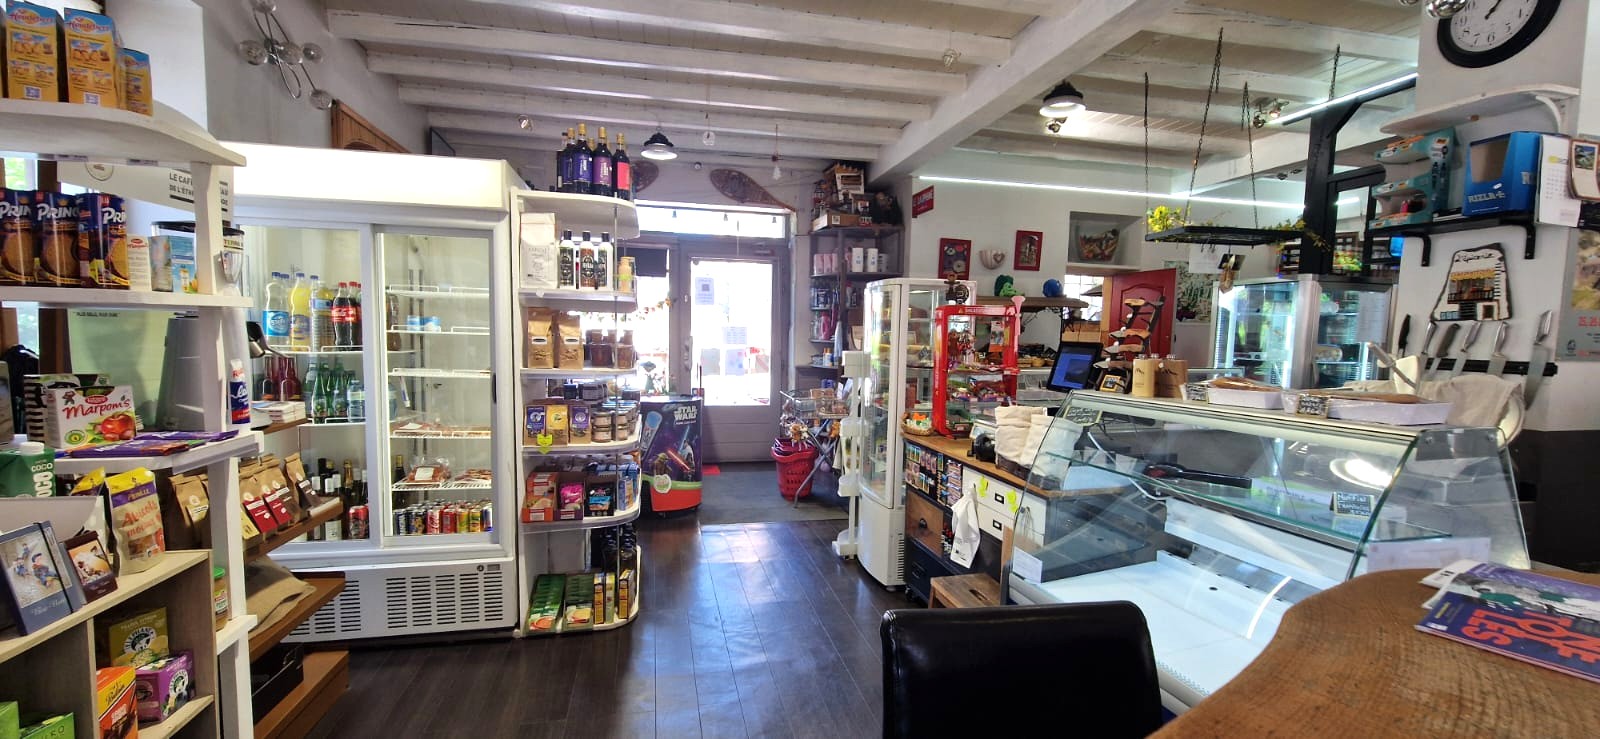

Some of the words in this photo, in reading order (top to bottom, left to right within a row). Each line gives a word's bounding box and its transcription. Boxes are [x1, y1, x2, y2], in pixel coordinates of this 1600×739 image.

[674, 405, 697, 414] STAR
[674, 411, 697, 421] WARS
[31, 462, 53, 472] COCO
